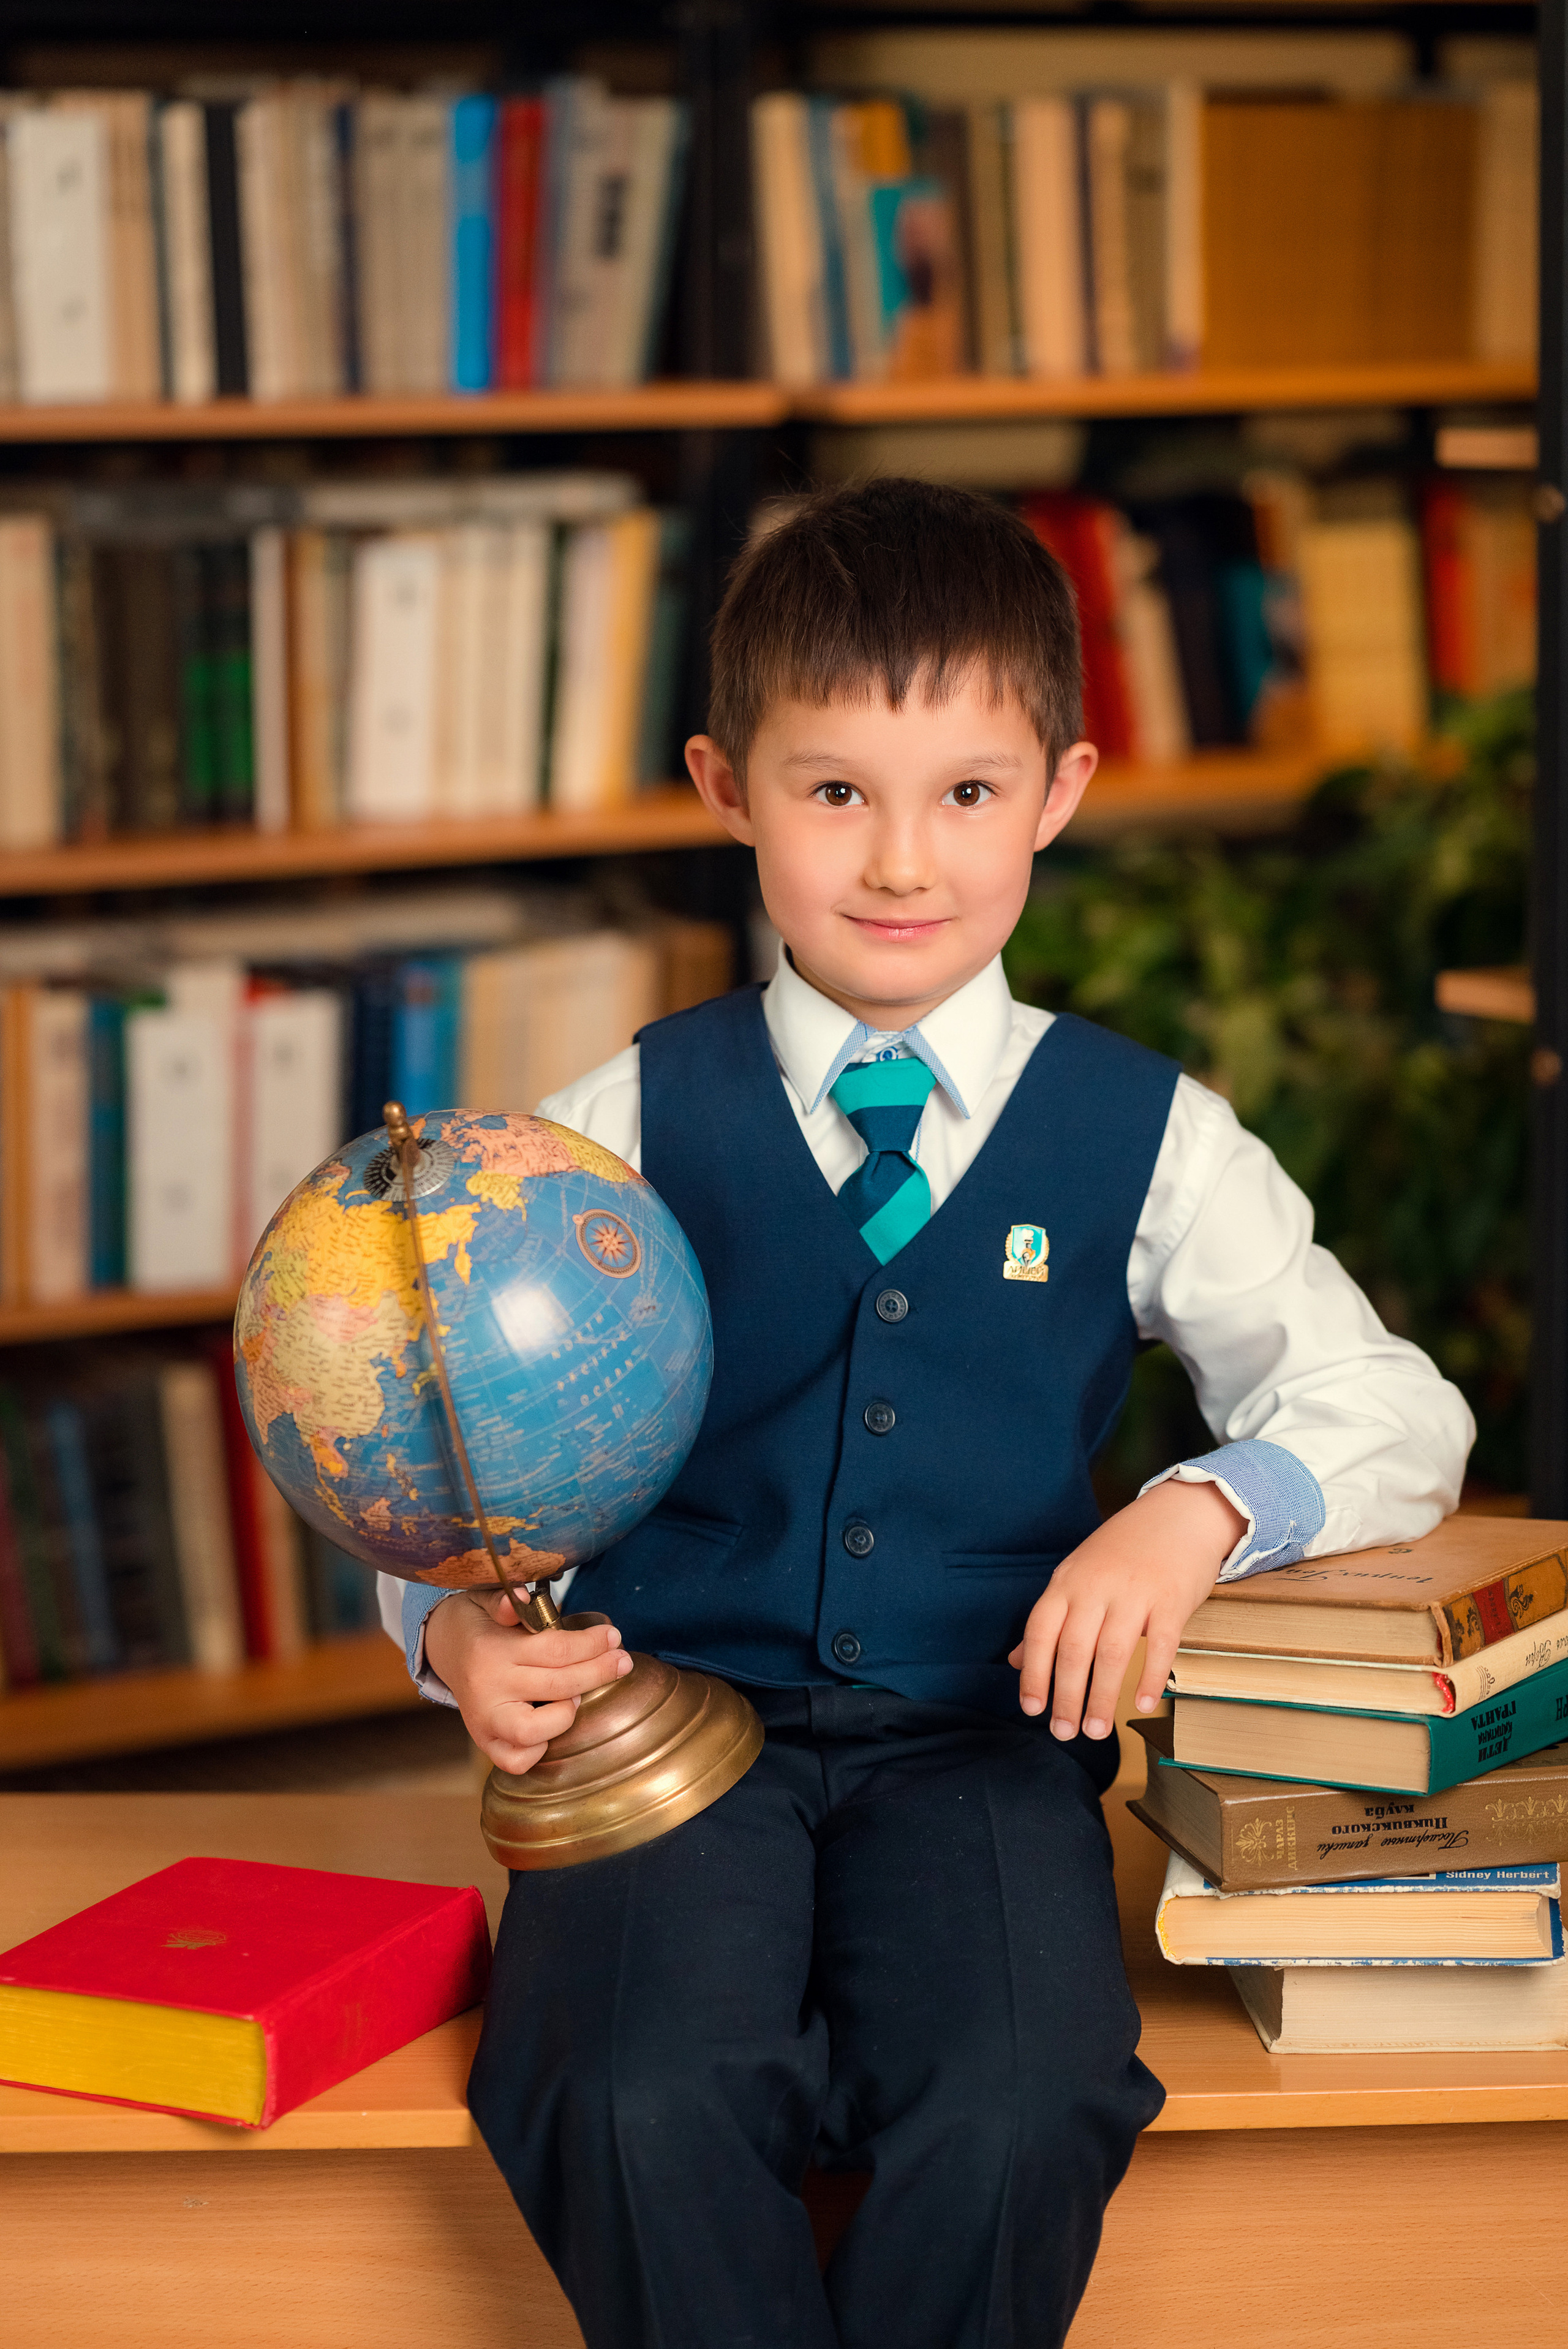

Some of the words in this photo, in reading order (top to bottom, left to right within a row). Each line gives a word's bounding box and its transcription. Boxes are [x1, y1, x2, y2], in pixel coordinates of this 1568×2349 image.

[580, 1359, 634, 1405] OCEAN
[1471, 1700, 1517, 1731] ГРАНТА
[1478, 1720, 1512, 1745] КАПИТАНА
[1478, 1736, 1509, 1763] ДЕТИ
[1364, 1802, 1415, 1820] клуба
[1286, 1806, 1298, 1870] ДИККЕНС
[1332, 1817, 1448, 1834] Пиквикского
[1317, 1833, 1373, 1860] записки
[1381, 1829, 1469, 1850] Посмертные
[1446, 1871, 1491, 1880] Sidney
